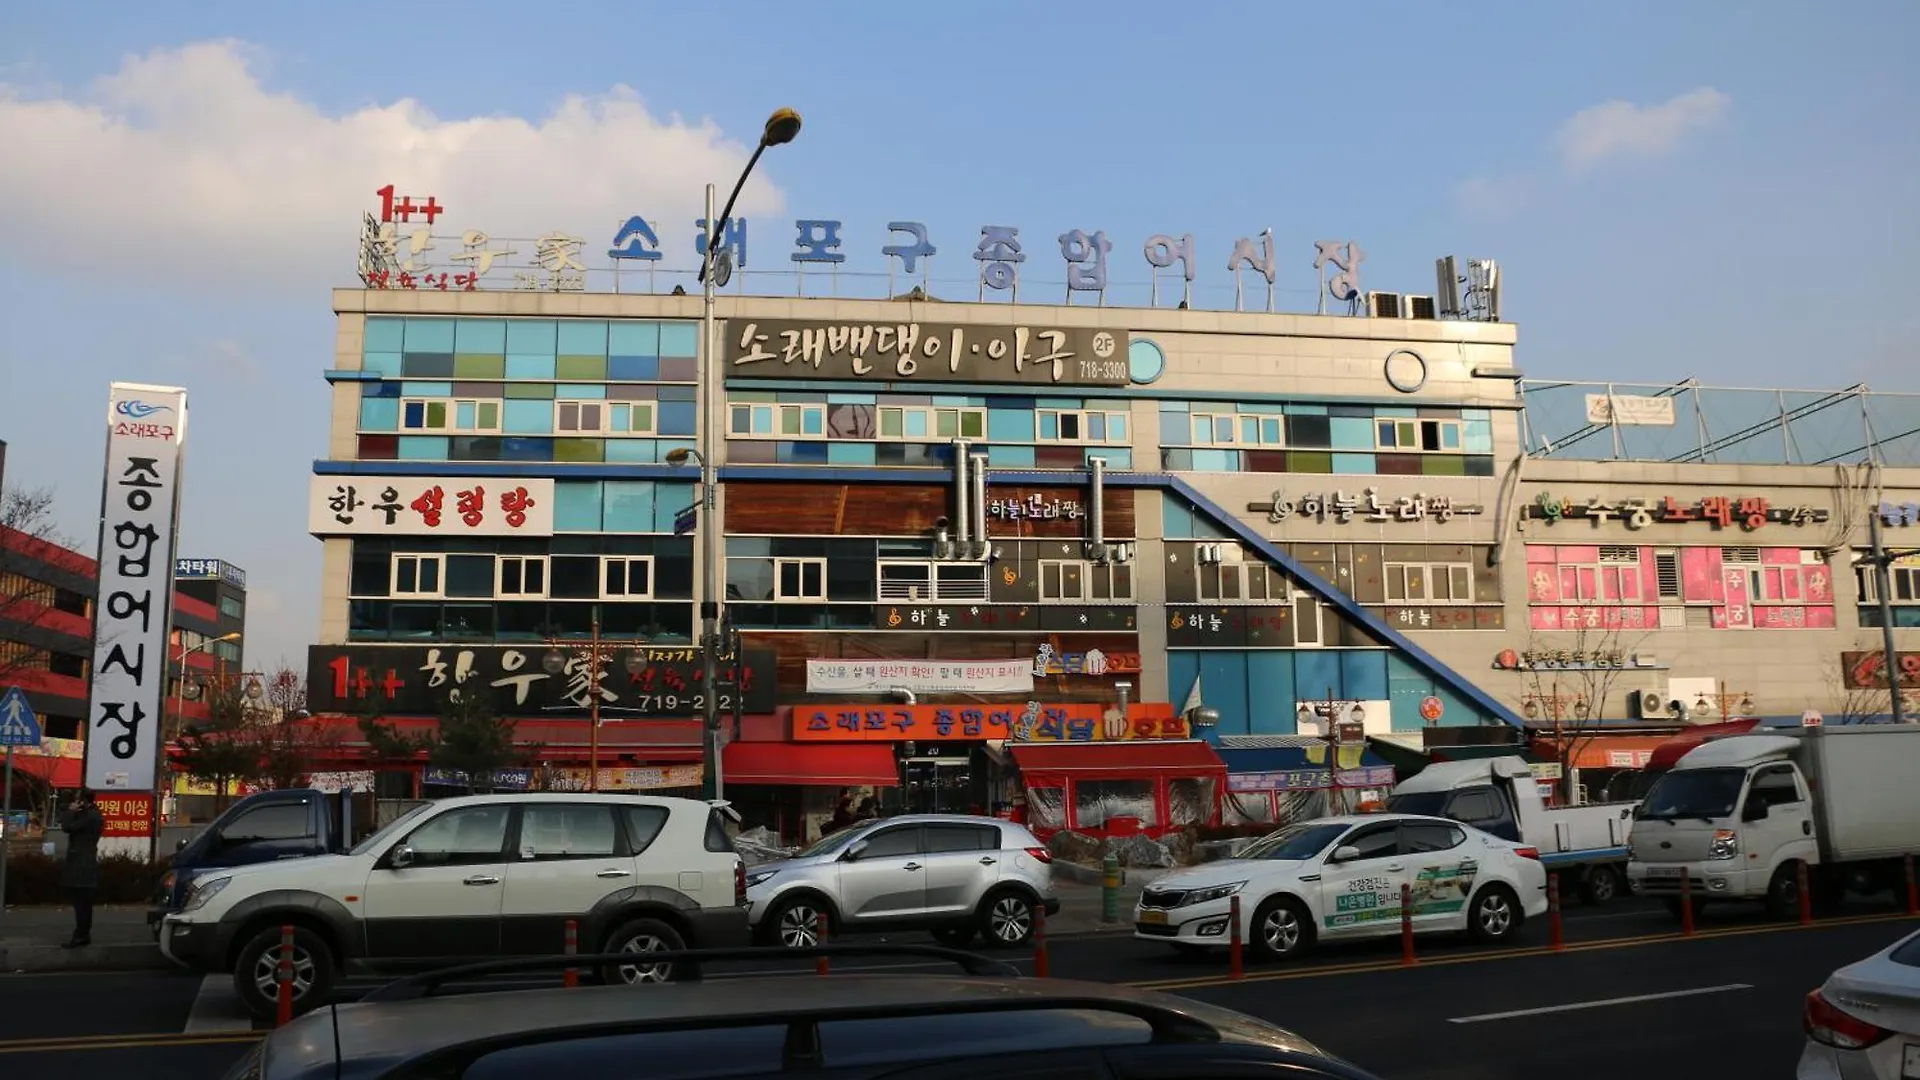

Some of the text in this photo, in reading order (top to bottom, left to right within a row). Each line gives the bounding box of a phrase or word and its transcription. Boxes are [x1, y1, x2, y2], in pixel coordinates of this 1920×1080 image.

[376, 184, 444, 225] 1++
[608, 215, 1366, 302] 소래포구종합어시장
[1094, 337, 1112, 351] 2F
[1080, 360, 1126, 378] 718-3300
[114, 422, 174, 440] 소래포구
[327, 486, 405, 525] 한우
[1585, 496, 1653, 528] 수궁
[176, 560, 218, 576] 차타워
[97, 456, 163, 759] 종합어시장
[911, 608, 951, 627] 하늘
[1399, 609, 1431, 627] 하늘
[1189, 613, 1223, 632] 하늘
[328, 655, 405, 699] 1++
[806, 710, 915, 733] 소래포구
